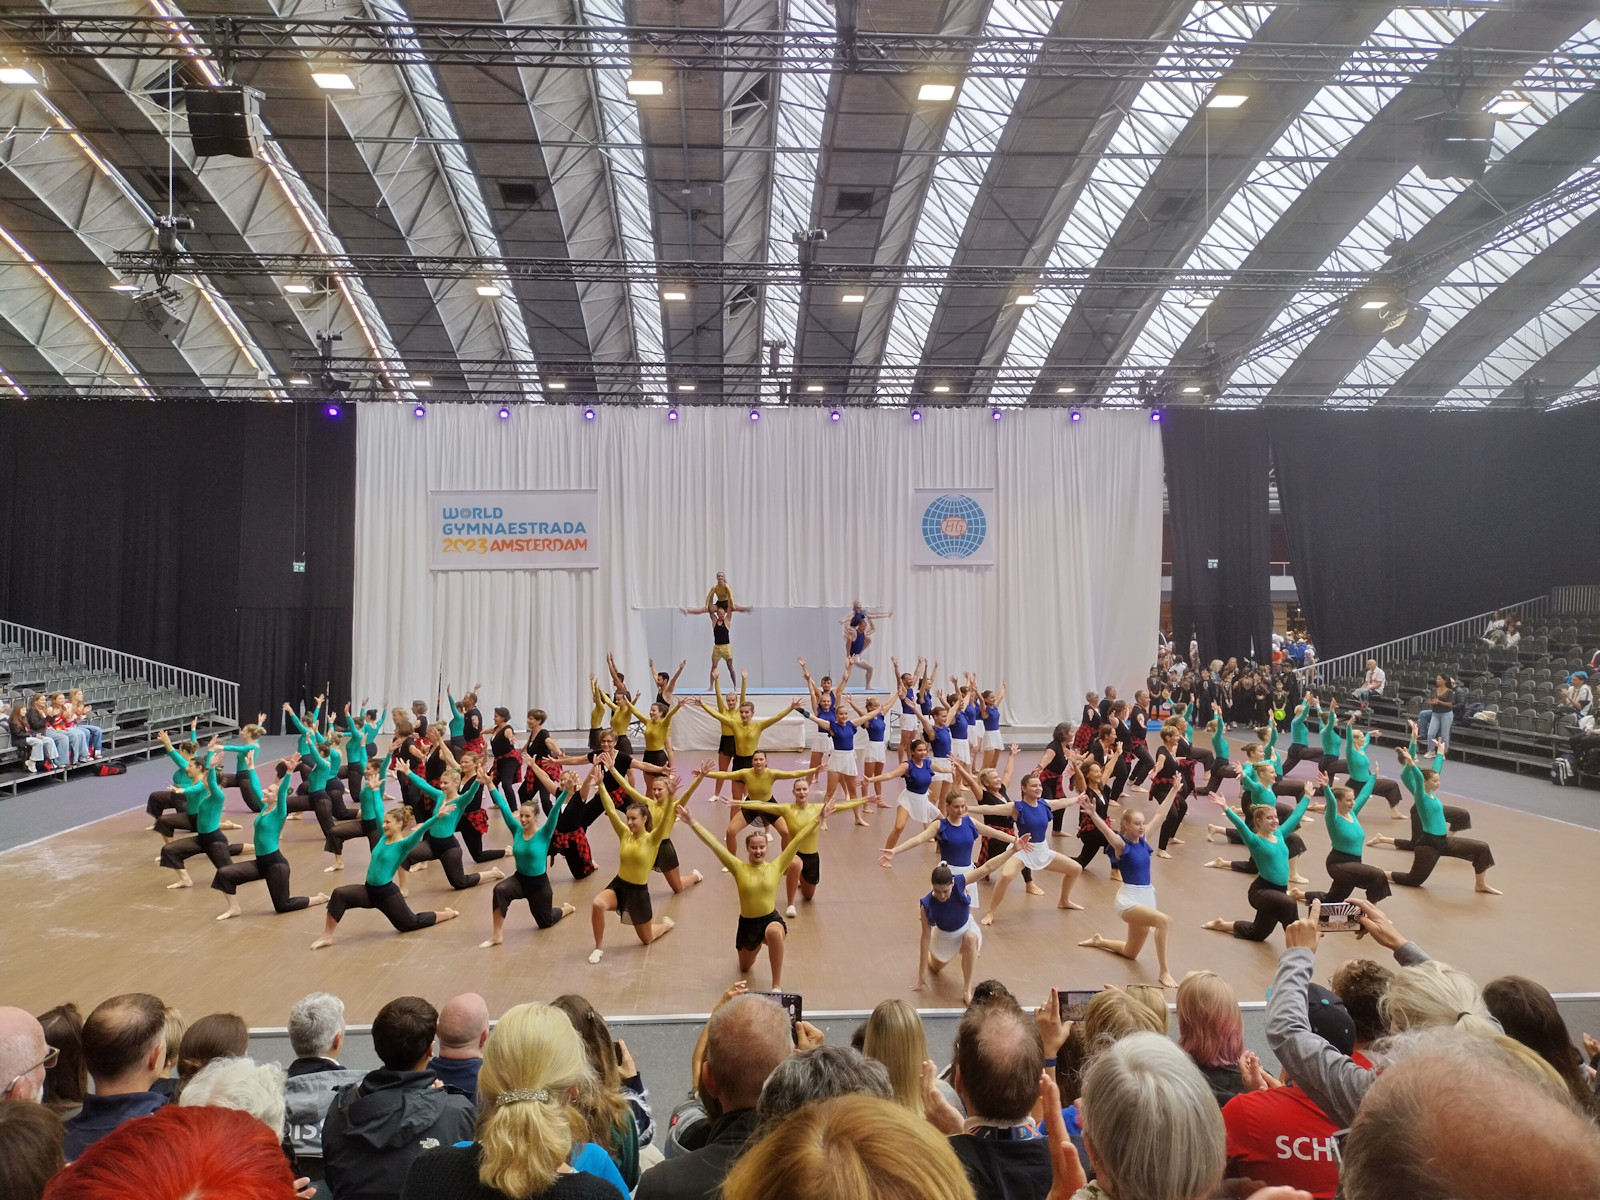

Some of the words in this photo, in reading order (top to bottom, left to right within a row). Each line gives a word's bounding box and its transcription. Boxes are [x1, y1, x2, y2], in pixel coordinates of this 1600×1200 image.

[442, 507, 503, 520] WORLD
[442, 521, 587, 535] GYMNAESTRADA
[441, 537, 488, 554] 2023
[489, 538, 588, 552] AMSTERDAM
